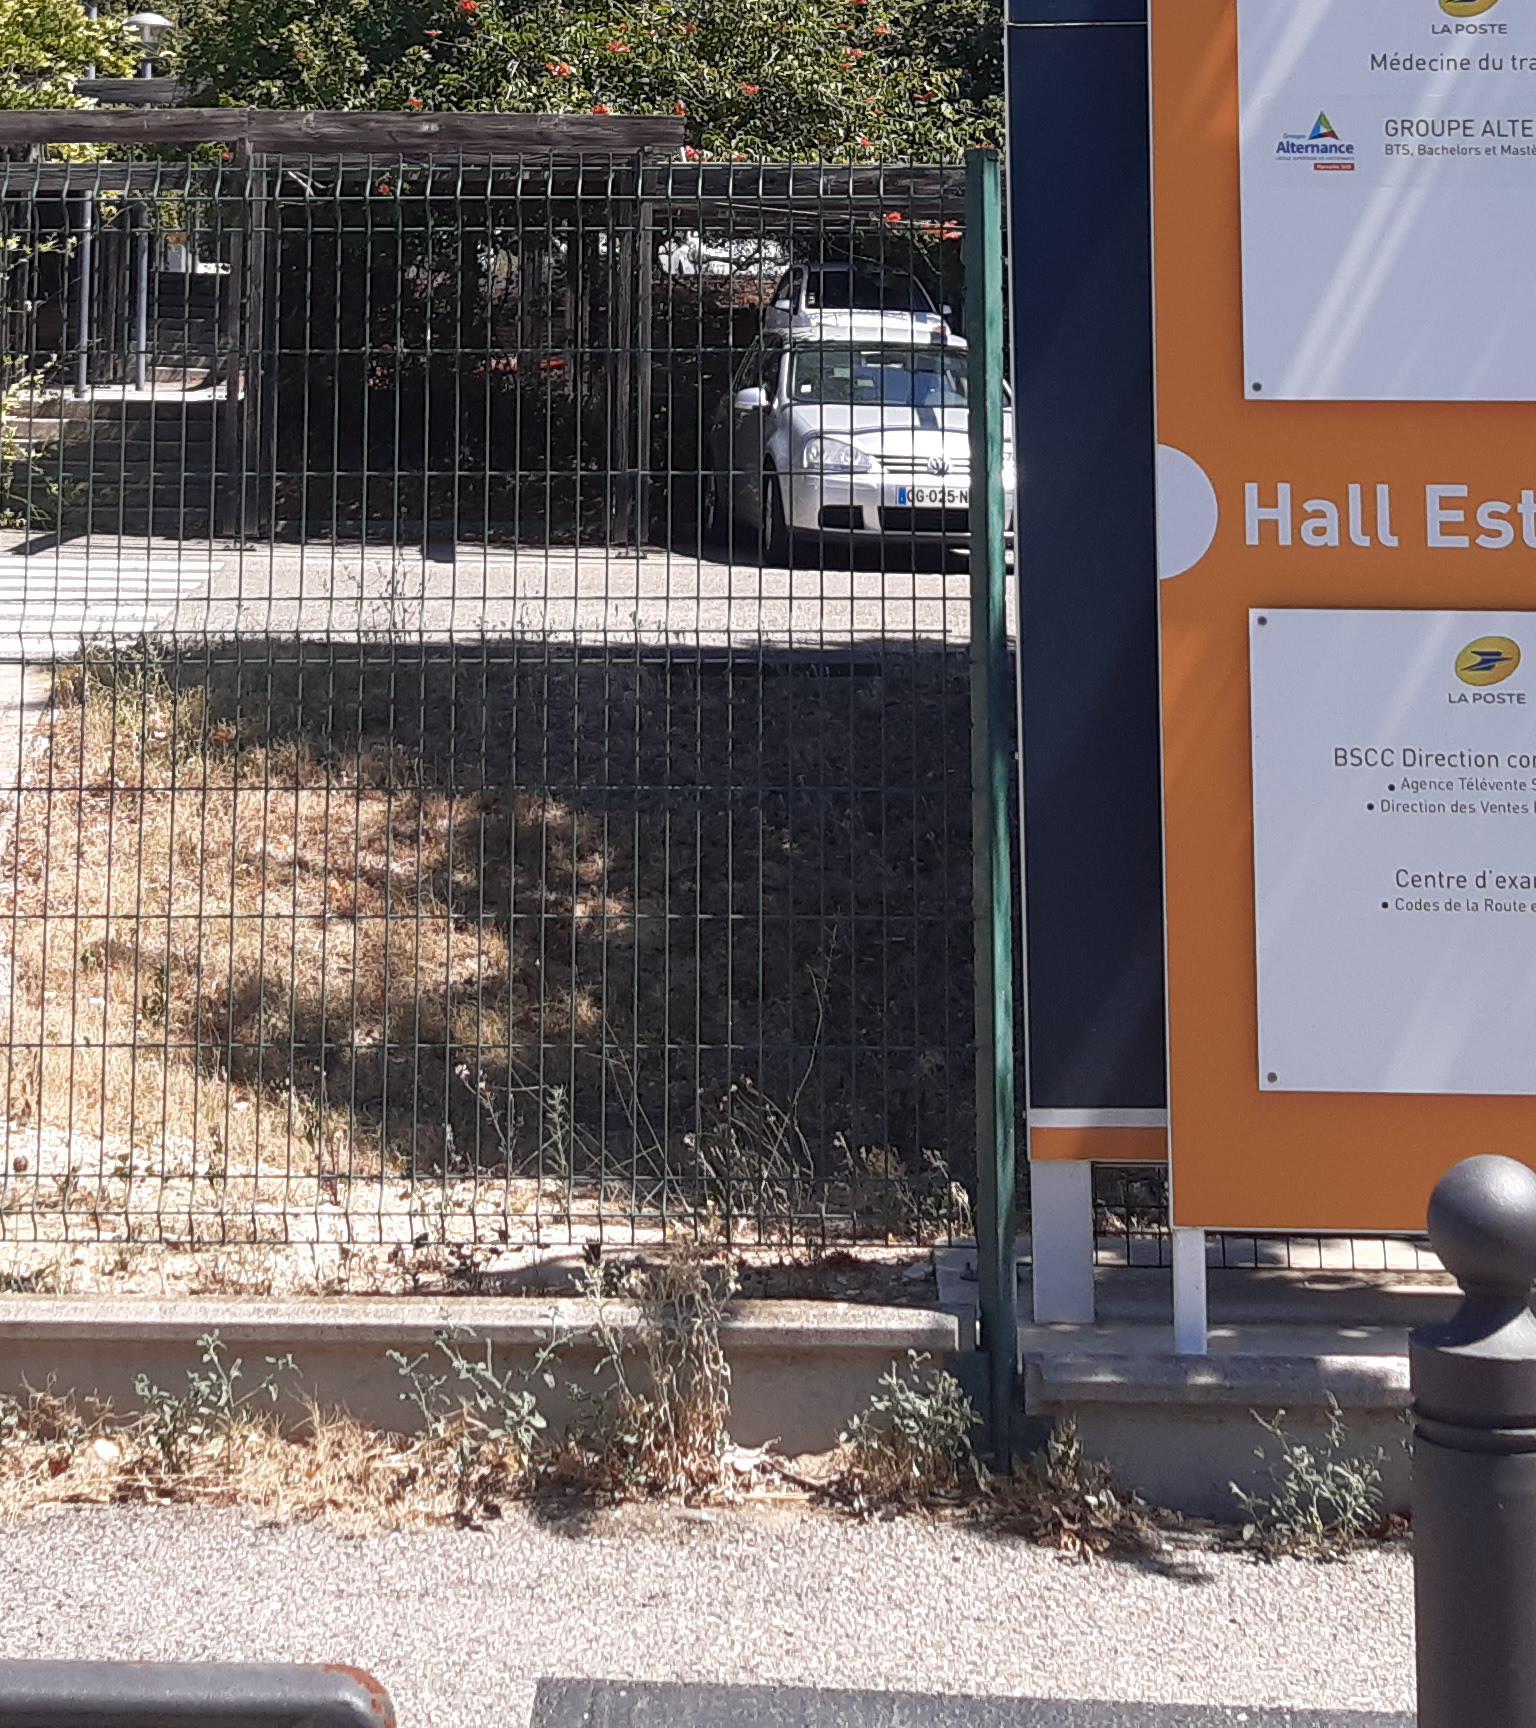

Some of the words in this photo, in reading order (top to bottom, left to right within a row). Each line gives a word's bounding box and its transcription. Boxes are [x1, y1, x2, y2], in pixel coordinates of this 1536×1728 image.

[1431, 23, 1453, 35] LA
[1454, 23, 1508, 35] POSTE
[1370, 52, 1471, 72] Médecine
[1478, 53, 1503, 71] du
[1384, 119, 1475, 138] GROUPE
[1275, 140, 1354, 154] Alternance
[1384, 143, 1414, 157] BTS,
[1417, 143, 1481, 156] Bachelors
[1484, 144, 1497, 156] et
[1244, 482, 1399, 548] Hall
[1448, 692, 1470, 704] LA
[1472, 692, 1527, 705] POSTE
[1334, 747, 1395, 768] BSCC
[1402, 748, 1500, 769] Direction
[1400, 777, 1454, 794] Agence
[1458, 777, 1527, 792] Télévente
[1380, 799, 1446, 813] Direction
[1450, 801, 1476, 814] des
[1480, 801, 1529, 815] Ventes
[1395, 868, 1467, 889] Centre
[1394, 897, 1440, 912] Codes
[1444, 898, 1462, 912] de
[1466, 898, 1479, 912] la
[1484, 898, 1527, 913] Route
